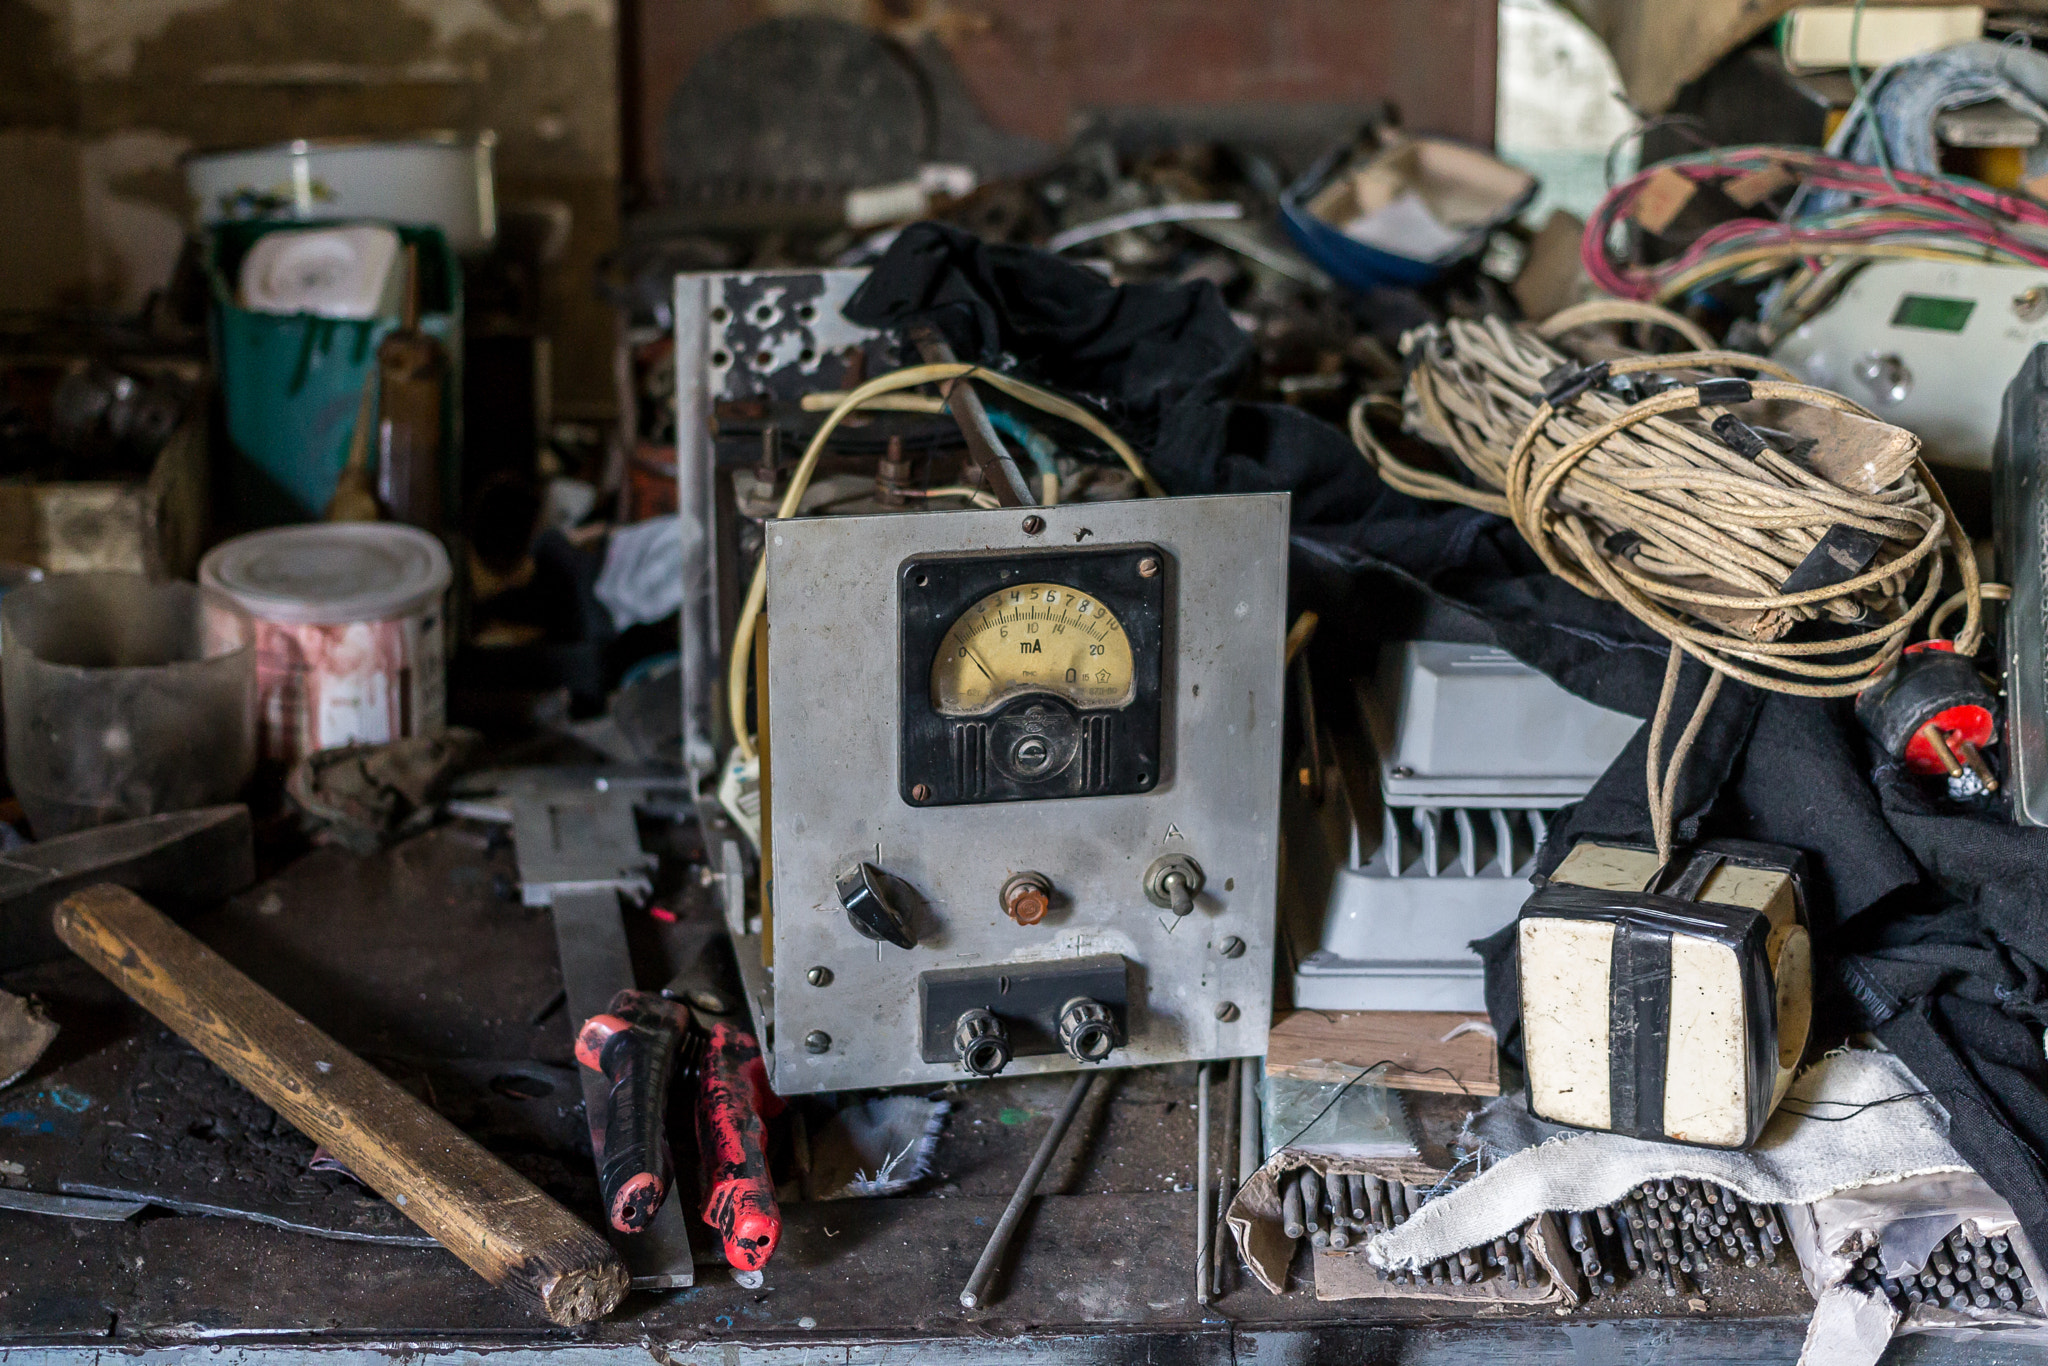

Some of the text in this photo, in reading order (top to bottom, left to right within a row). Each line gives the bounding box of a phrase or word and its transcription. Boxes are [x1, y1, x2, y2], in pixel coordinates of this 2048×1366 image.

[1010, 590, 1021, 602] 4
[1029, 587, 1040, 600] 5
[1046, 589, 1057, 603] 6
[1065, 593, 1076, 607] 7
[1078, 599, 1091, 613] 8
[1093, 607, 1107, 620] 9
[958, 621, 1105, 658] 0 6 10 14 20
[1020, 638, 1042, 654] mA
[1082, 673, 1090, 681] 15
